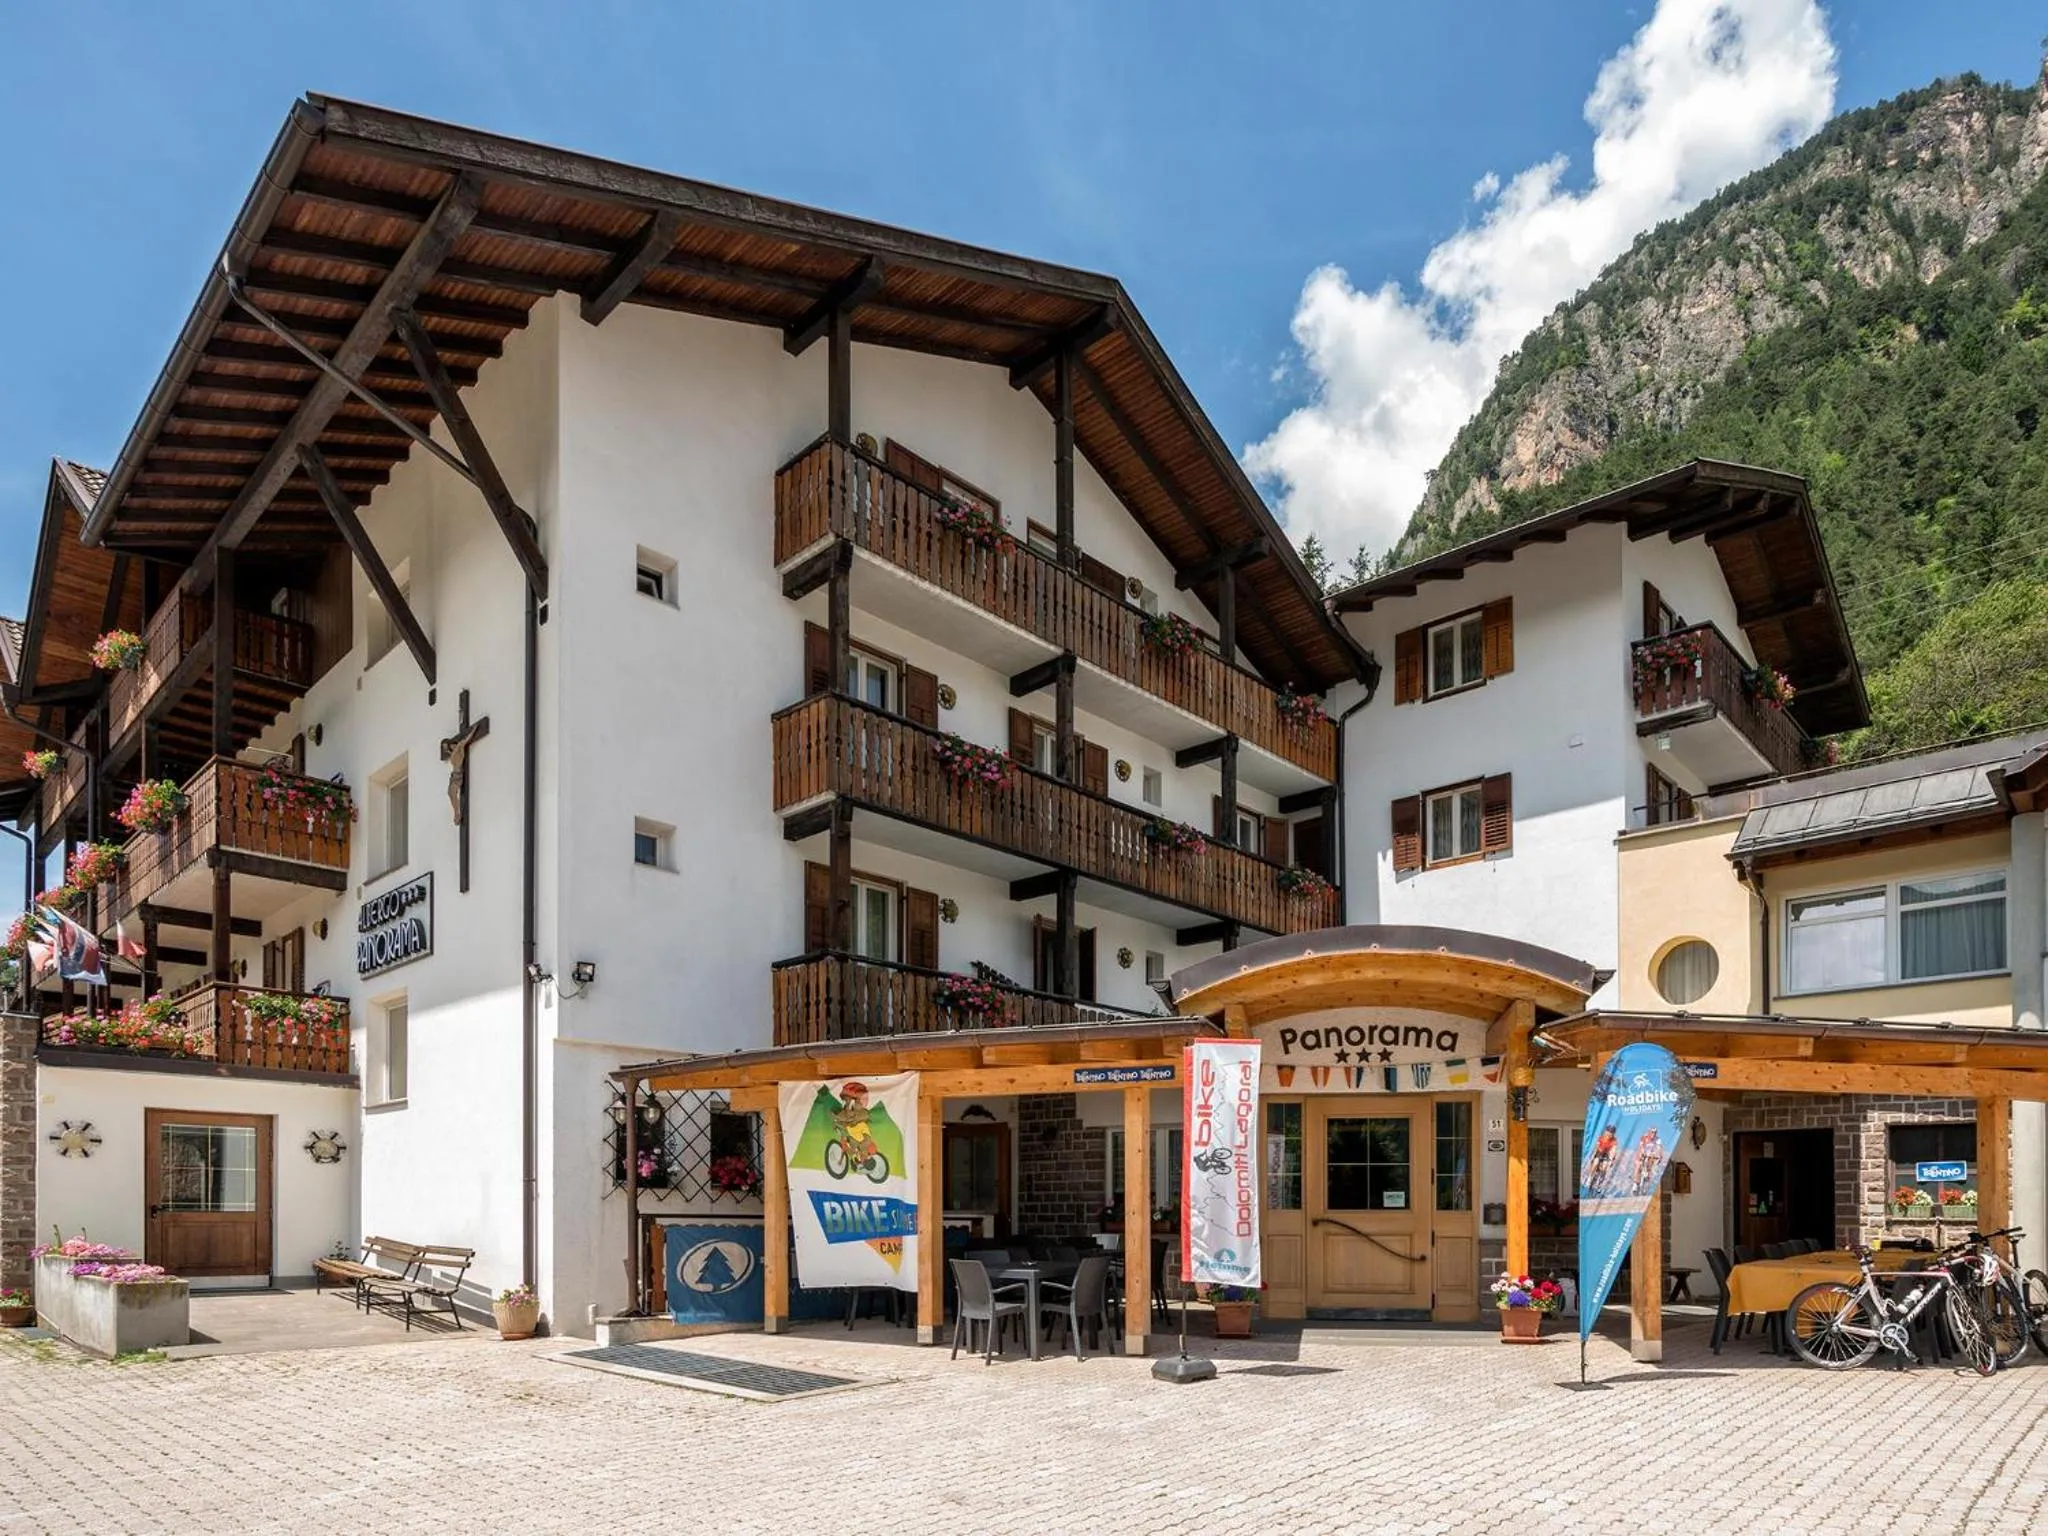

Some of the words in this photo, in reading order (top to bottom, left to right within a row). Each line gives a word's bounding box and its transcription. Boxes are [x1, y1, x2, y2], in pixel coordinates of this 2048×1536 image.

[356, 917, 424, 973] PANORAMA
[1280, 1024, 1459, 1055] Panorama
[1195, 1059, 1216, 1147] bike
[1606, 1089, 1679, 1108] Roadbike
[823, 1199, 889, 1234] BIKE
[1234, 1151, 1252, 1237] Dolomiti
